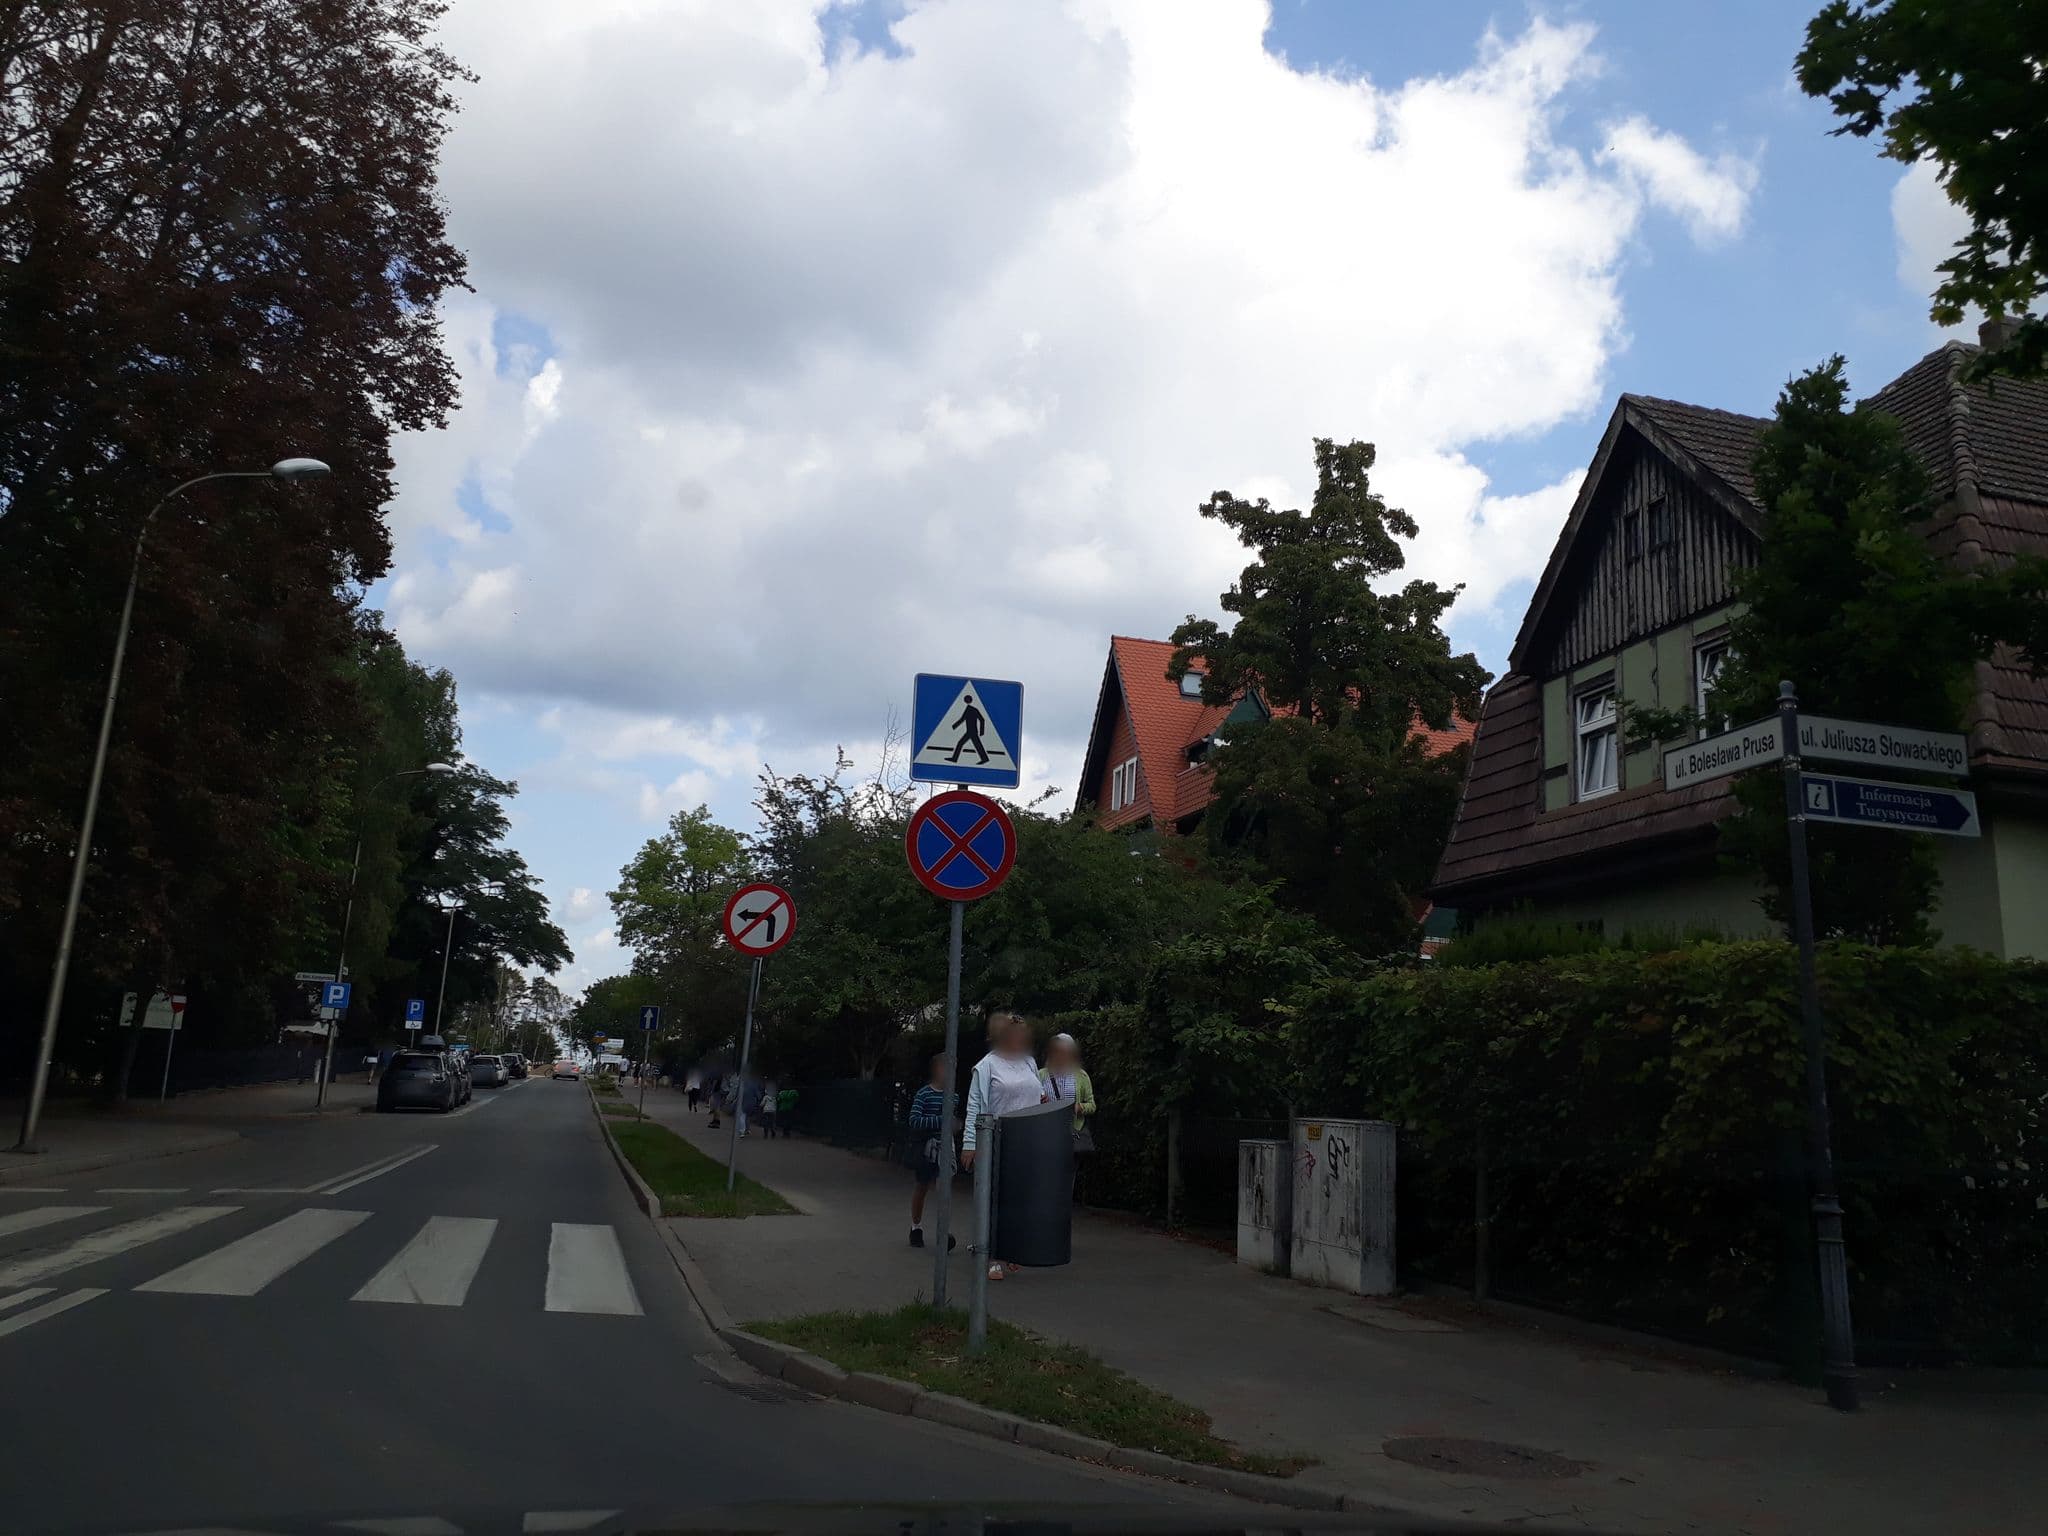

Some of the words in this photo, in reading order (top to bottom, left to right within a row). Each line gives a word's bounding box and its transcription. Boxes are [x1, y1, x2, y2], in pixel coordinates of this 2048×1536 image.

[1675, 757, 1687, 778] ul.
[1689, 745, 1740, 774] Bolesława
[1743, 734, 1775, 758] Prusa
[1801, 726, 1817, 747] ul.
[1821, 728, 1876, 754] Juliusza
[1880, 734, 1963, 769] Słowackiego
[1859, 786, 1932, 809] Informacja
[1856, 802, 1937, 824] Turystyczna
[328, 985, 345, 1004] P
[410, 1002, 421, 1015] P
